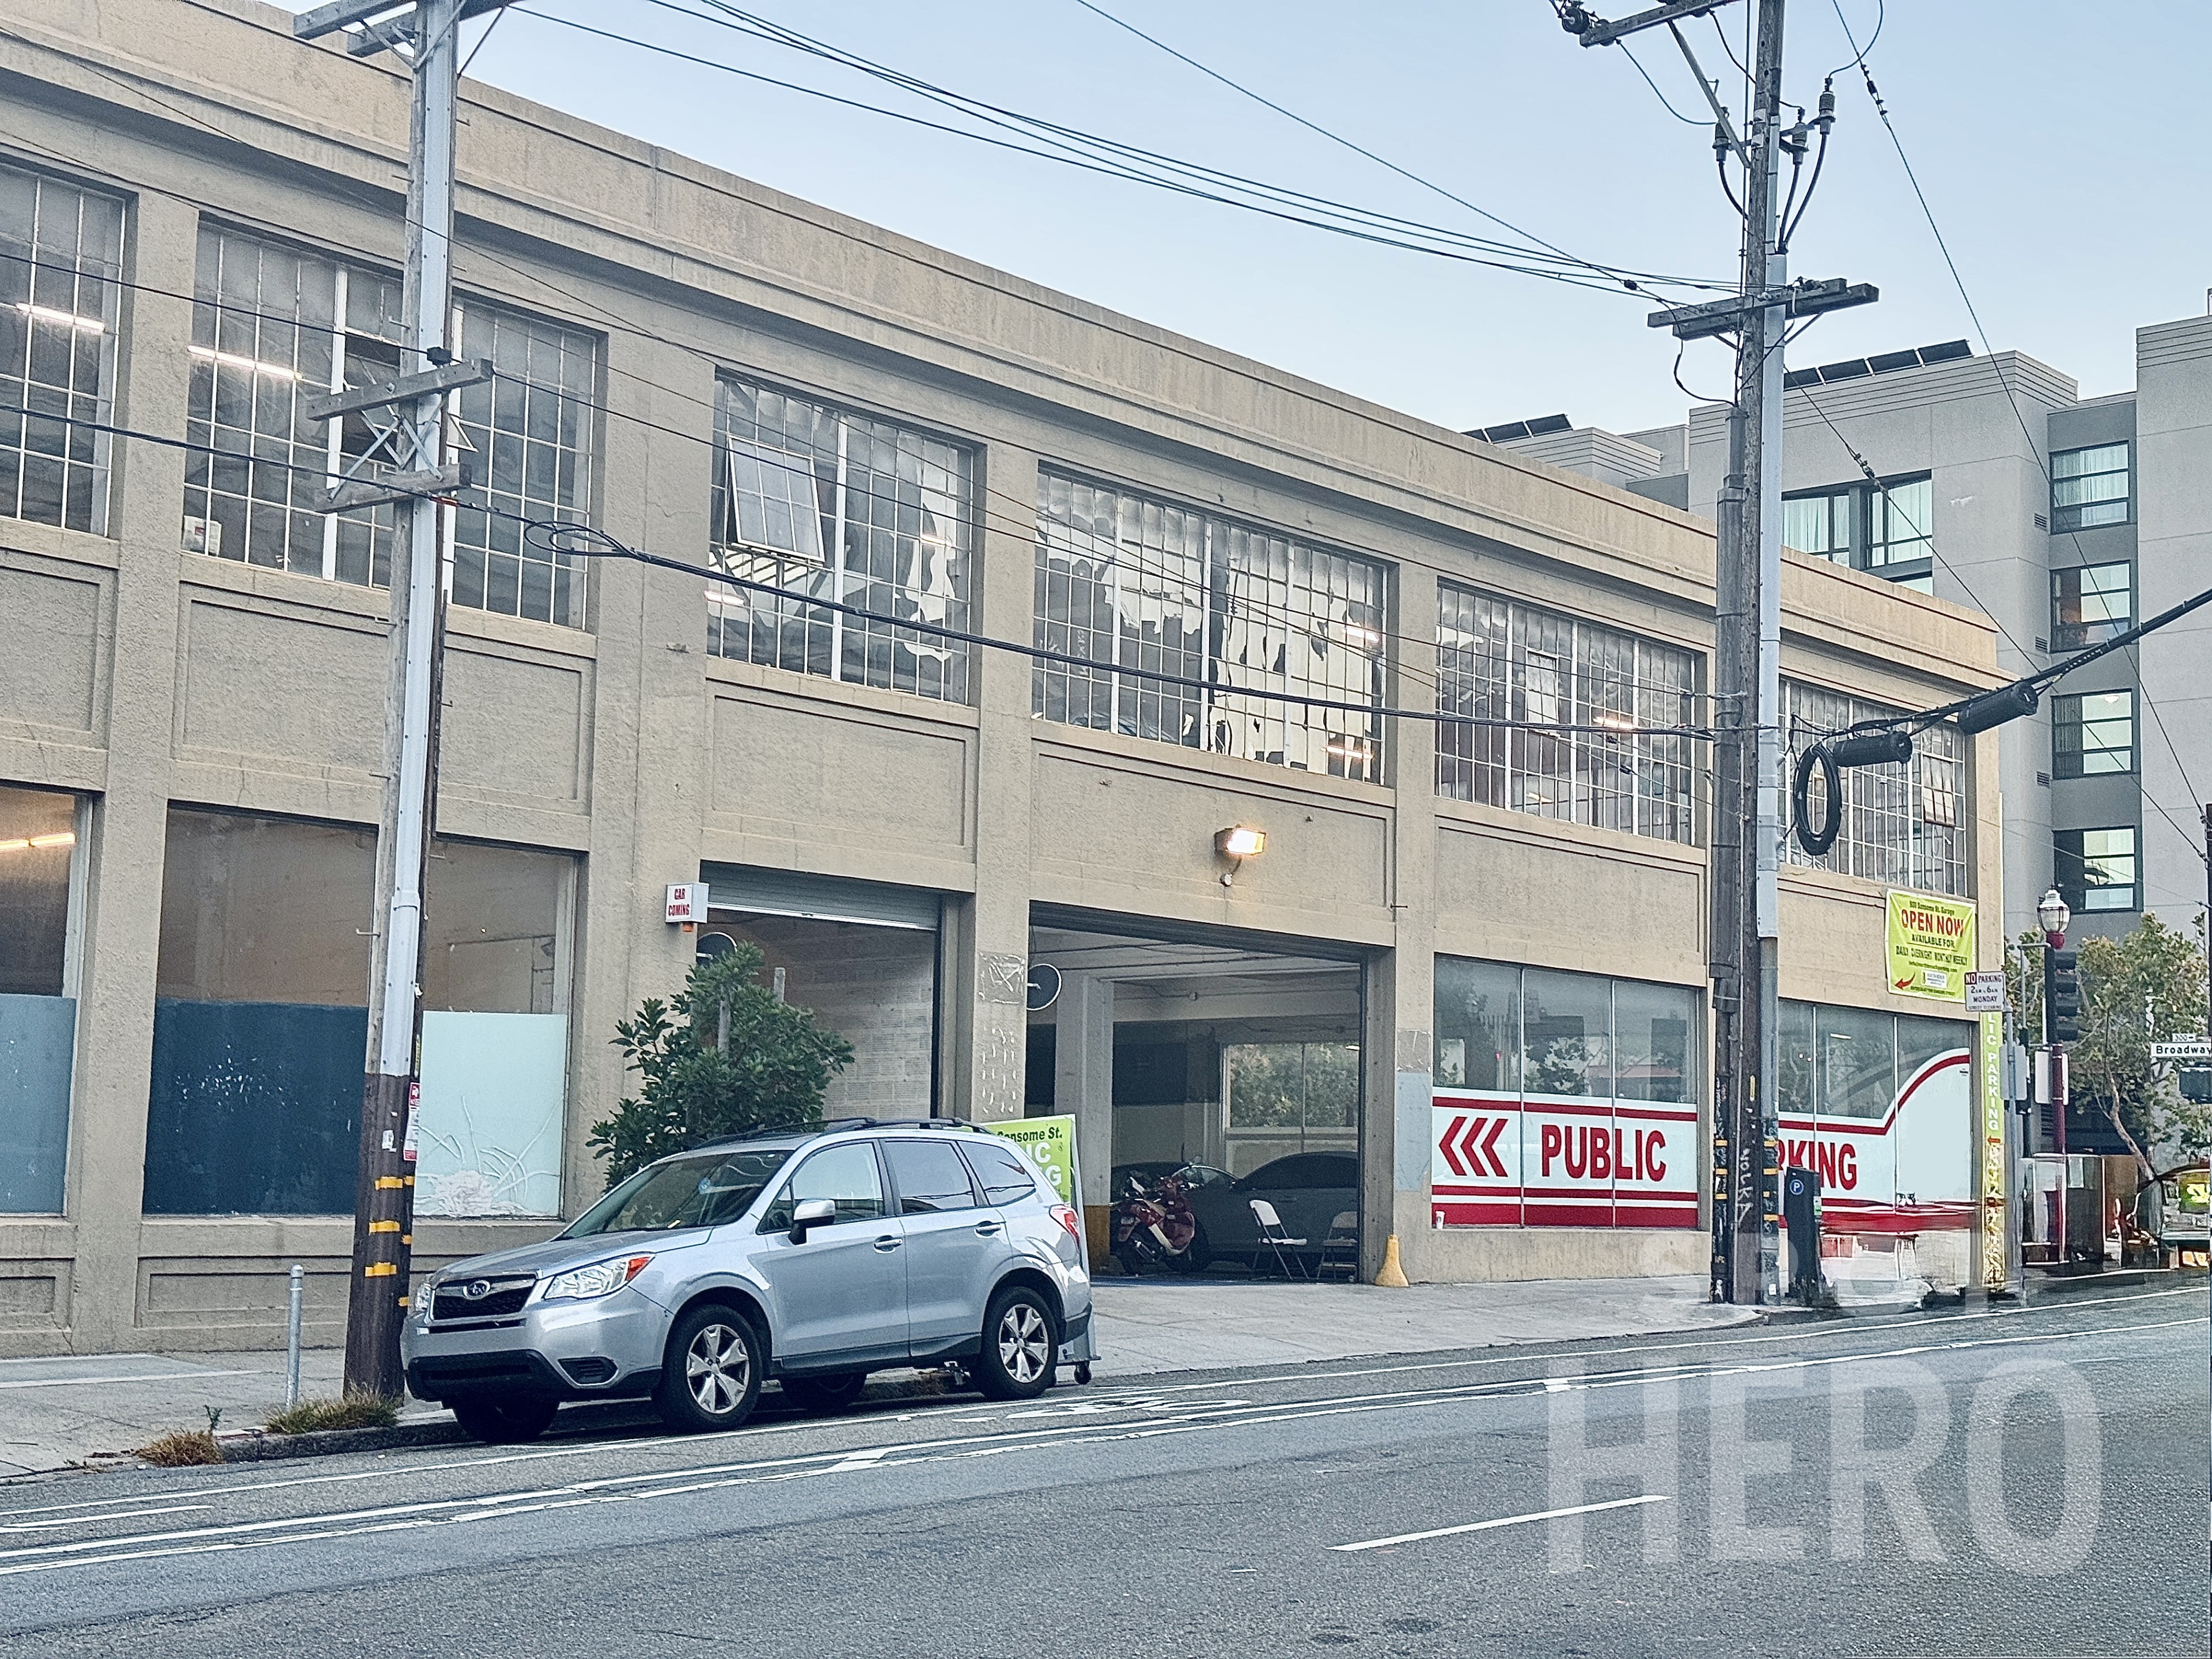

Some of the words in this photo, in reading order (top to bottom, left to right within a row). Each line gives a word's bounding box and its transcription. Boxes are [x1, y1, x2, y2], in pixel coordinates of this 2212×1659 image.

[675, 888, 685, 900] CAR
[668, 904, 690, 916] COMING
[1902, 909, 1933, 933] OPEN
[1937, 915, 1964, 938] NOW
[1912, 934, 1942, 946] AVAILABLE
[1942, 938, 1955, 949] FOR
[1965, 974, 1976, 983] NO
[1987, 1012, 1997, 1046] LIC
[2156, 1046, 2211, 1055] Broadway
[1987, 1053, 1999, 1131] PARKING
[998, 1131, 1045, 1142] nsome
[1048, 1126, 1062, 1139] St.
[1542, 1124, 1666, 1181] PUBLIC
[1778, 1139, 1857, 1190] KING
